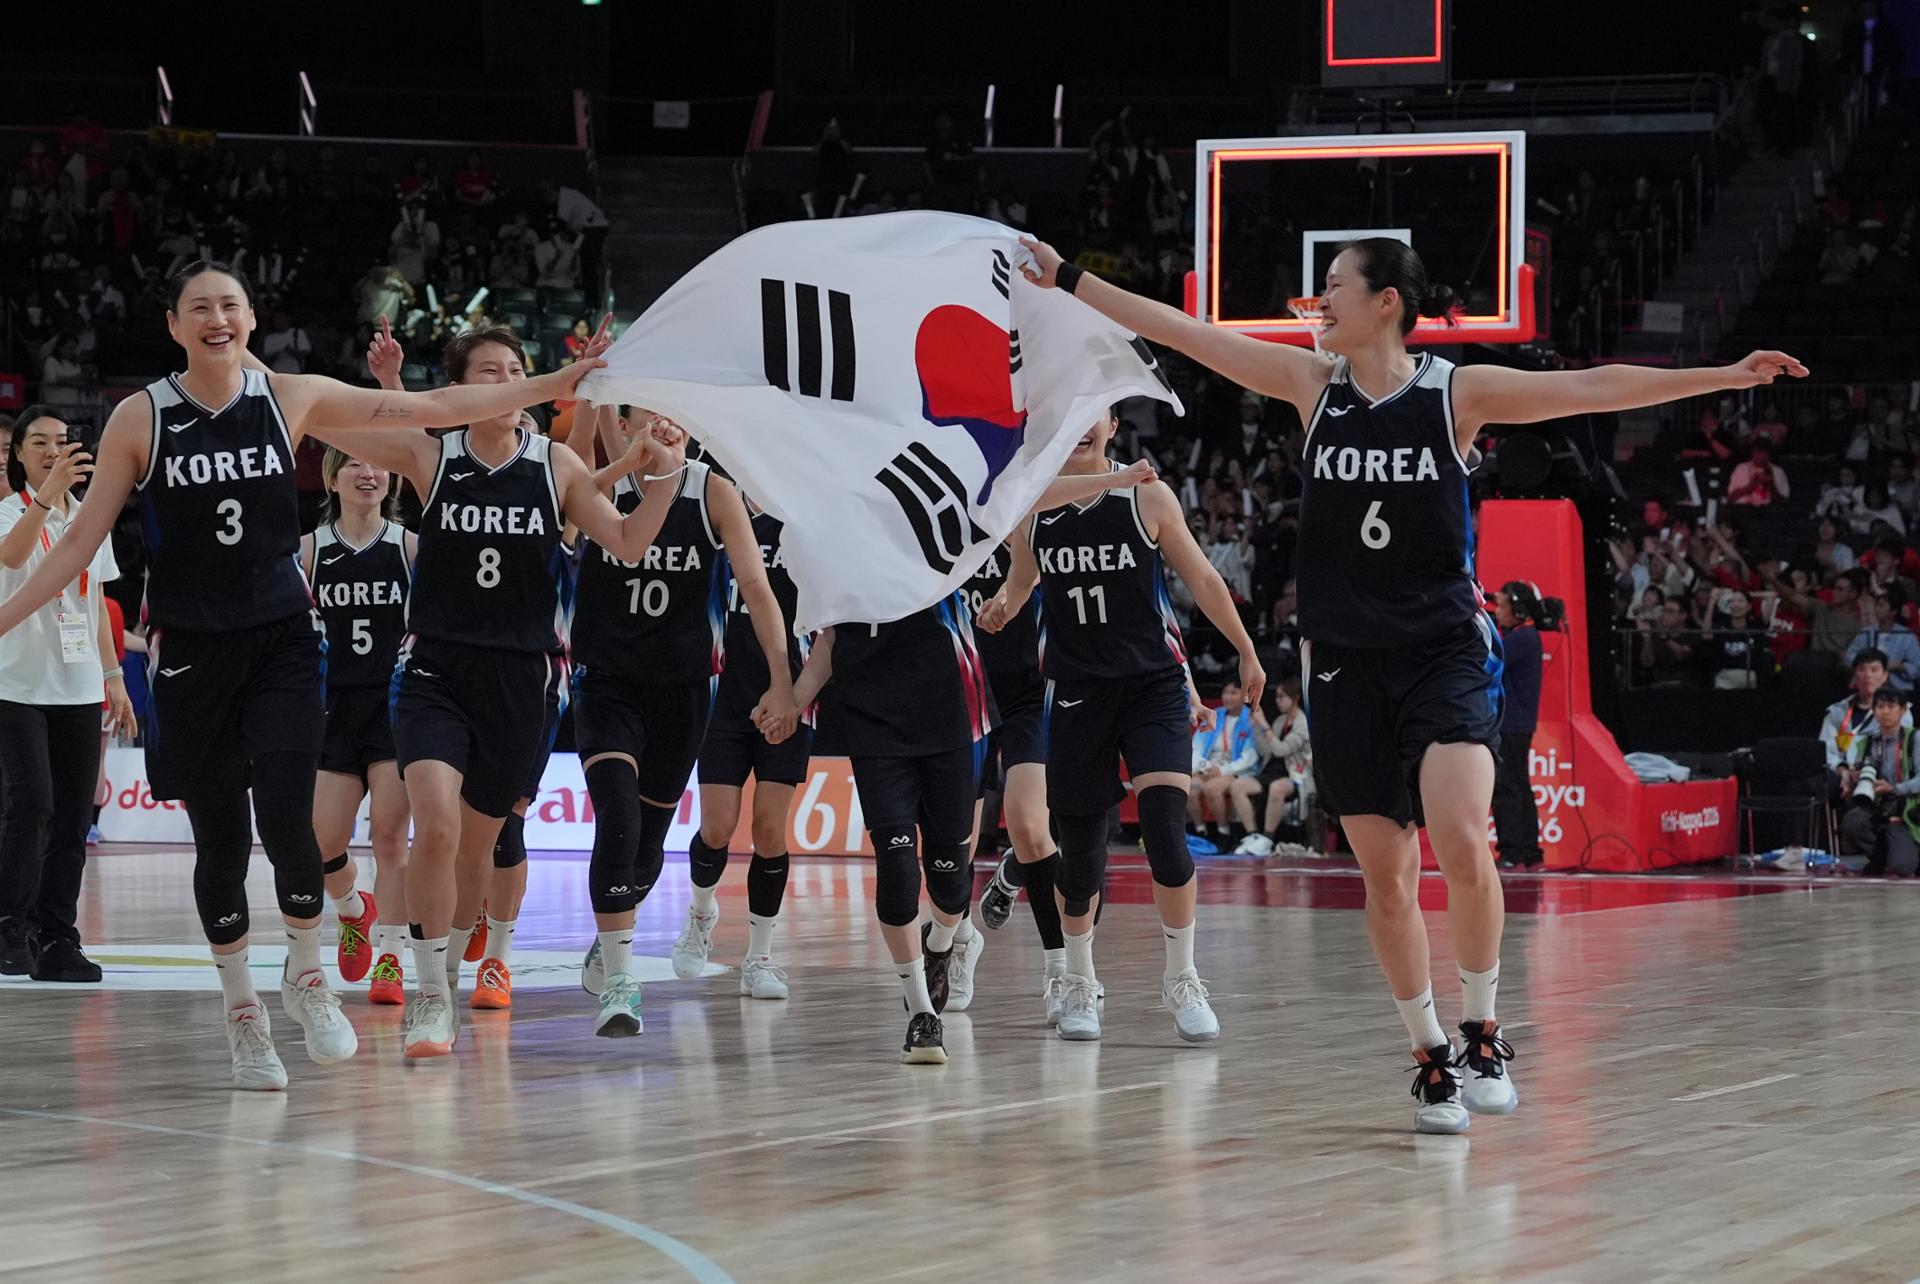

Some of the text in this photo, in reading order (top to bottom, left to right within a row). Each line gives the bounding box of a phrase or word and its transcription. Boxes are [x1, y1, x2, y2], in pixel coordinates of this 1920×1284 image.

[165, 444, 284, 488] KOREA
[1314, 445, 1440, 482] KOREA
[216, 498, 243, 545] 3
[441, 502, 545, 535] KOREA
[1360, 500, 1391, 549] 6
[476, 547, 501, 588] 8
[602, 545, 701, 571] KREA
[1038, 543, 1137, 573] KOREA
[318, 581, 402, 607] KOREA
[625, 578, 669, 617] 10
[729, 578, 750, 613] 1
[1067, 585, 1107, 624] 11
[352, 619, 373, 655] 5
[1528, 748, 1572, 777] hi-
[1531, 784, 1585, 814] oya
